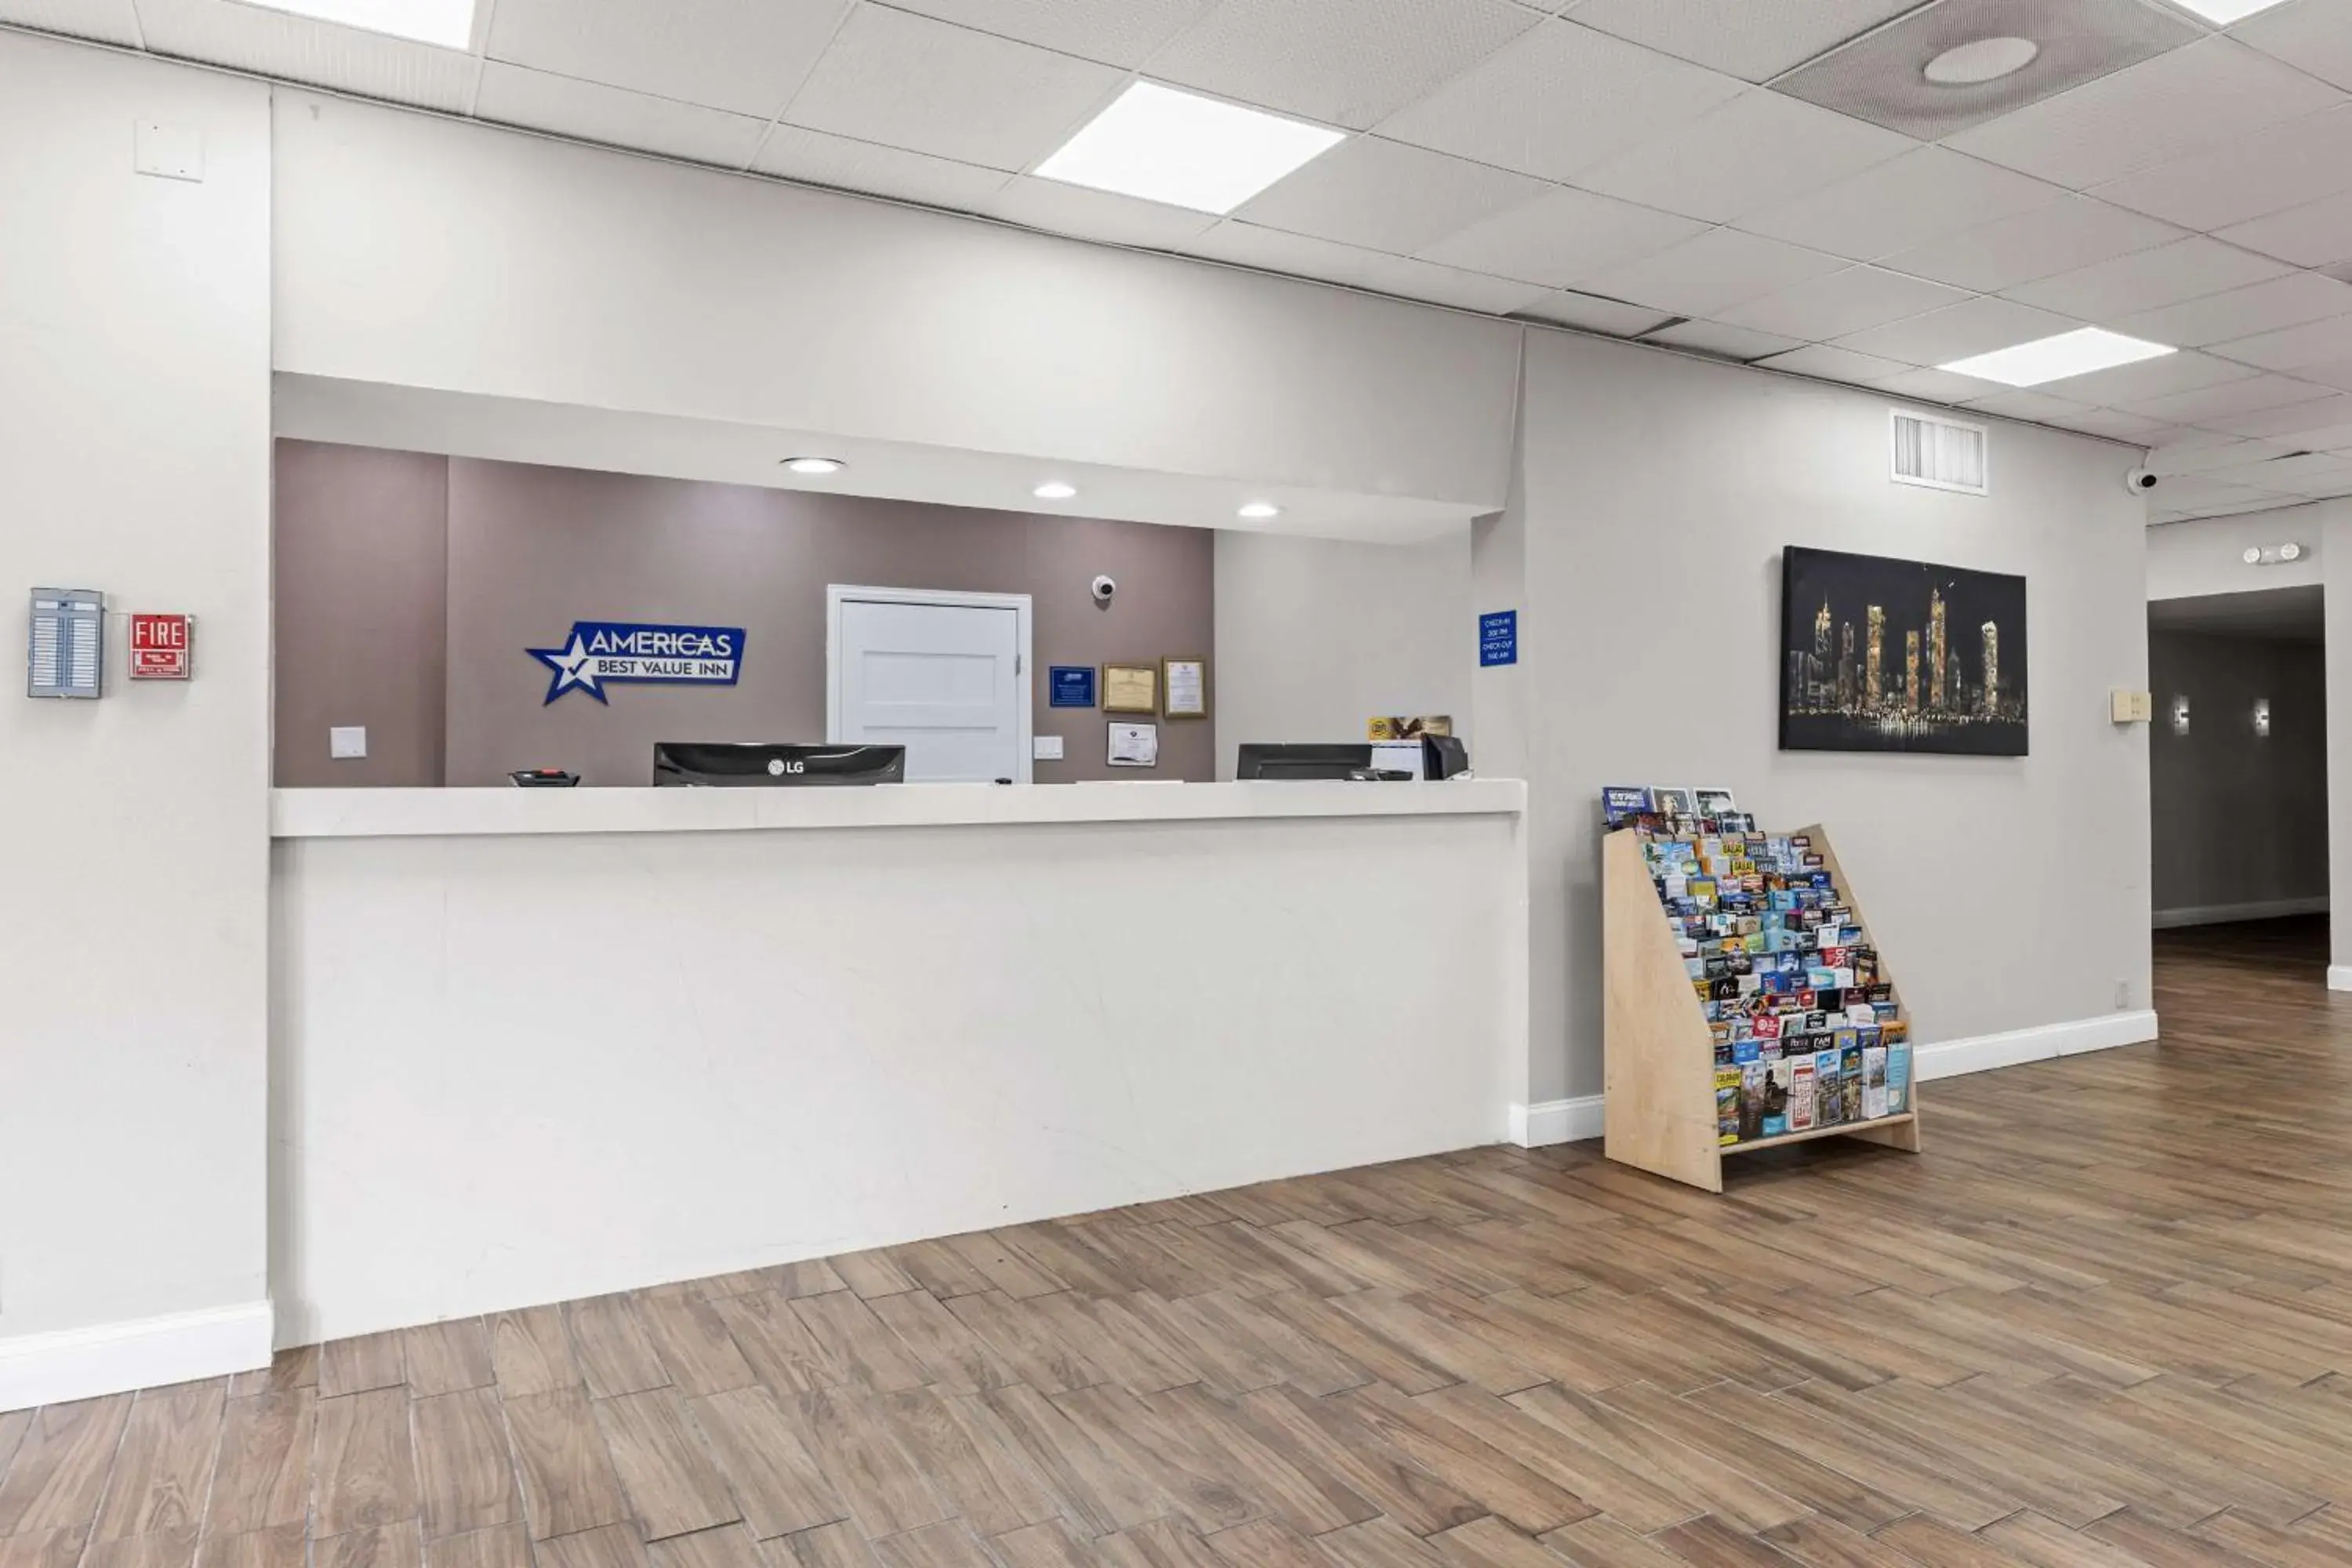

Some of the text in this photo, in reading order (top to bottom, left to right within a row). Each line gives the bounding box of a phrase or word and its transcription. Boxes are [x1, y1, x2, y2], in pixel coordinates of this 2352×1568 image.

[136, 622, 183, 645] FIRE
[590, 630, 731, 657] AMERICAS
[598, 660, 728, 675] BEST VALUE INN
[786, 761, 804, 773] LG
